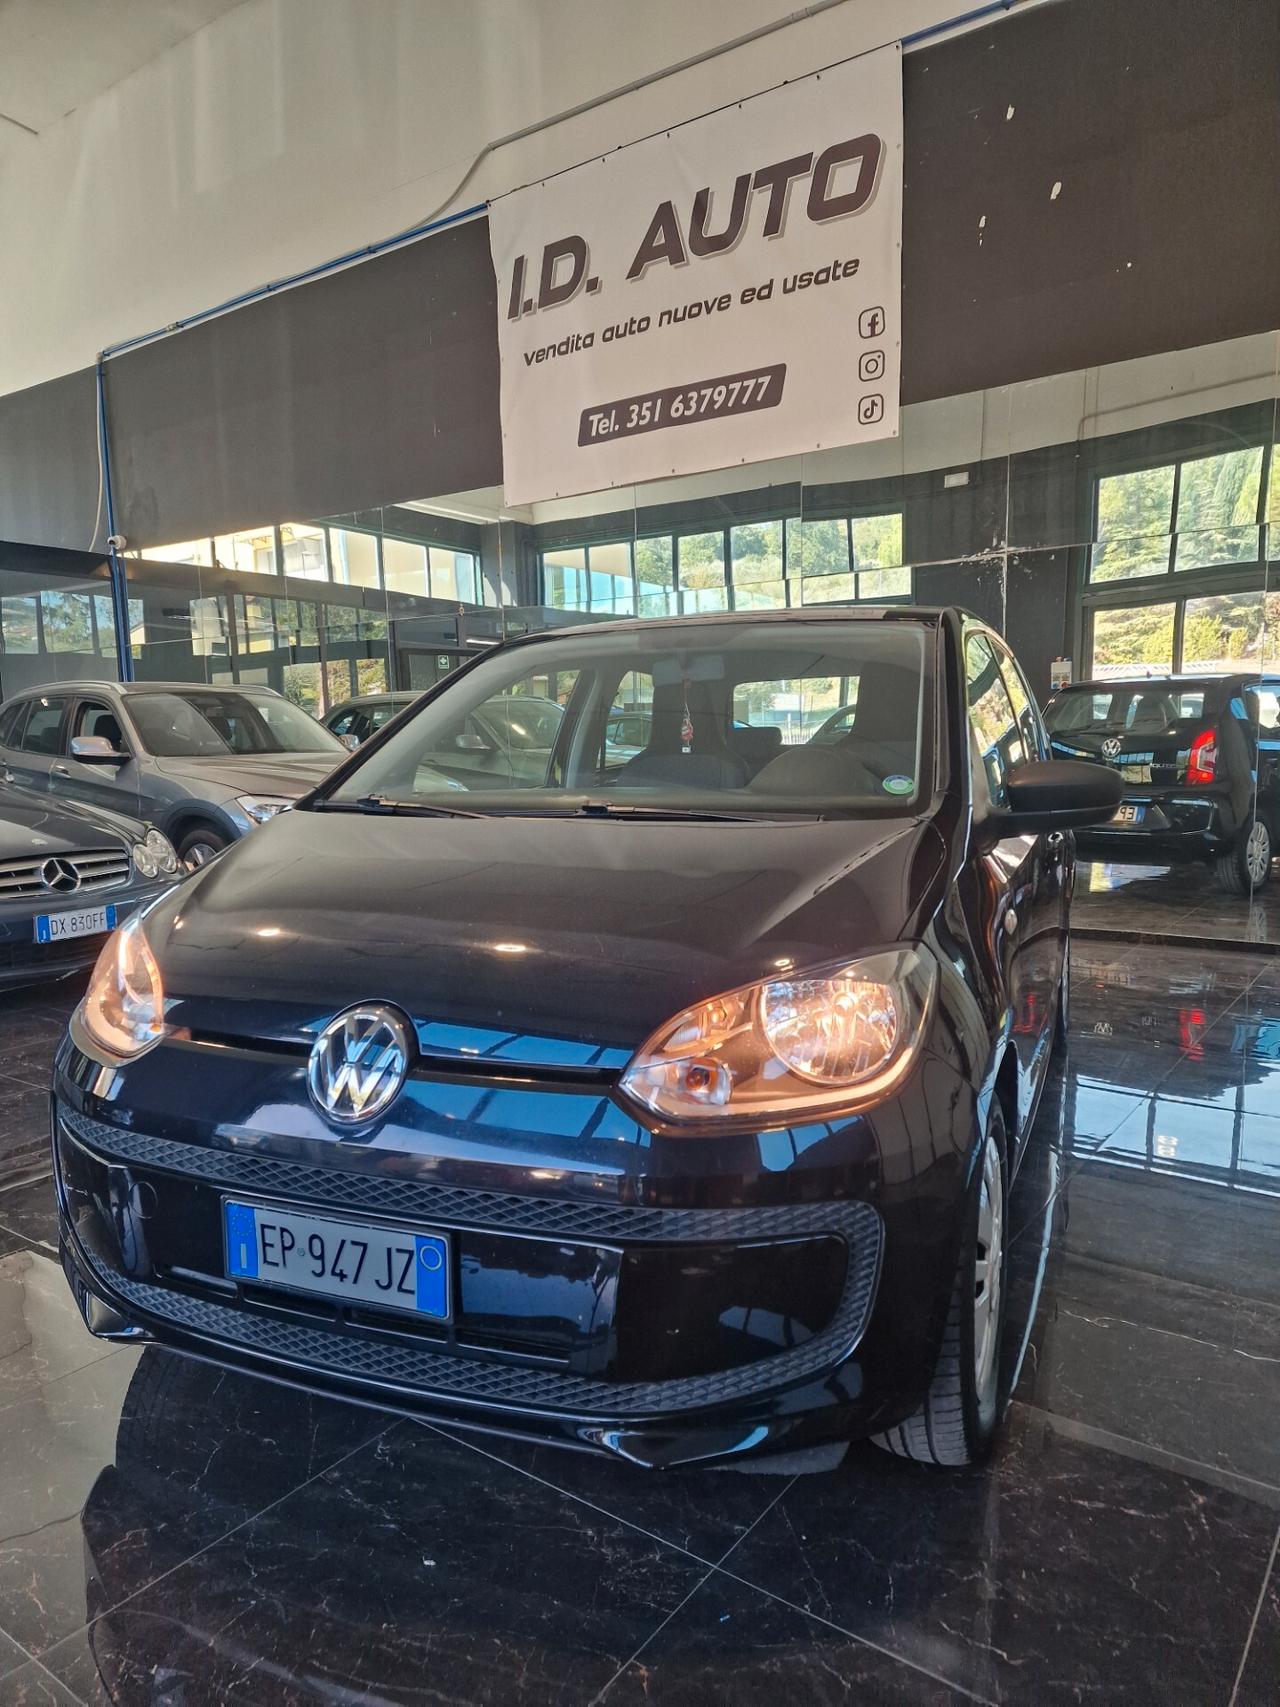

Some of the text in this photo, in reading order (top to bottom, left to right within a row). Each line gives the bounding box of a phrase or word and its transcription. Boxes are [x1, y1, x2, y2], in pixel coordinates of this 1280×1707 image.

[508, 133, 886, 321] I.D. AUTO
[523, 258, 860, 367] vendita auto nuove ed usate
[588, 375, 772, 437] Tel. 351 6379777
[259, 1223, 296, 1268] EP
[308, 1233, 369, 1285] 947
[375, 1247, 417, 1295] JZ
